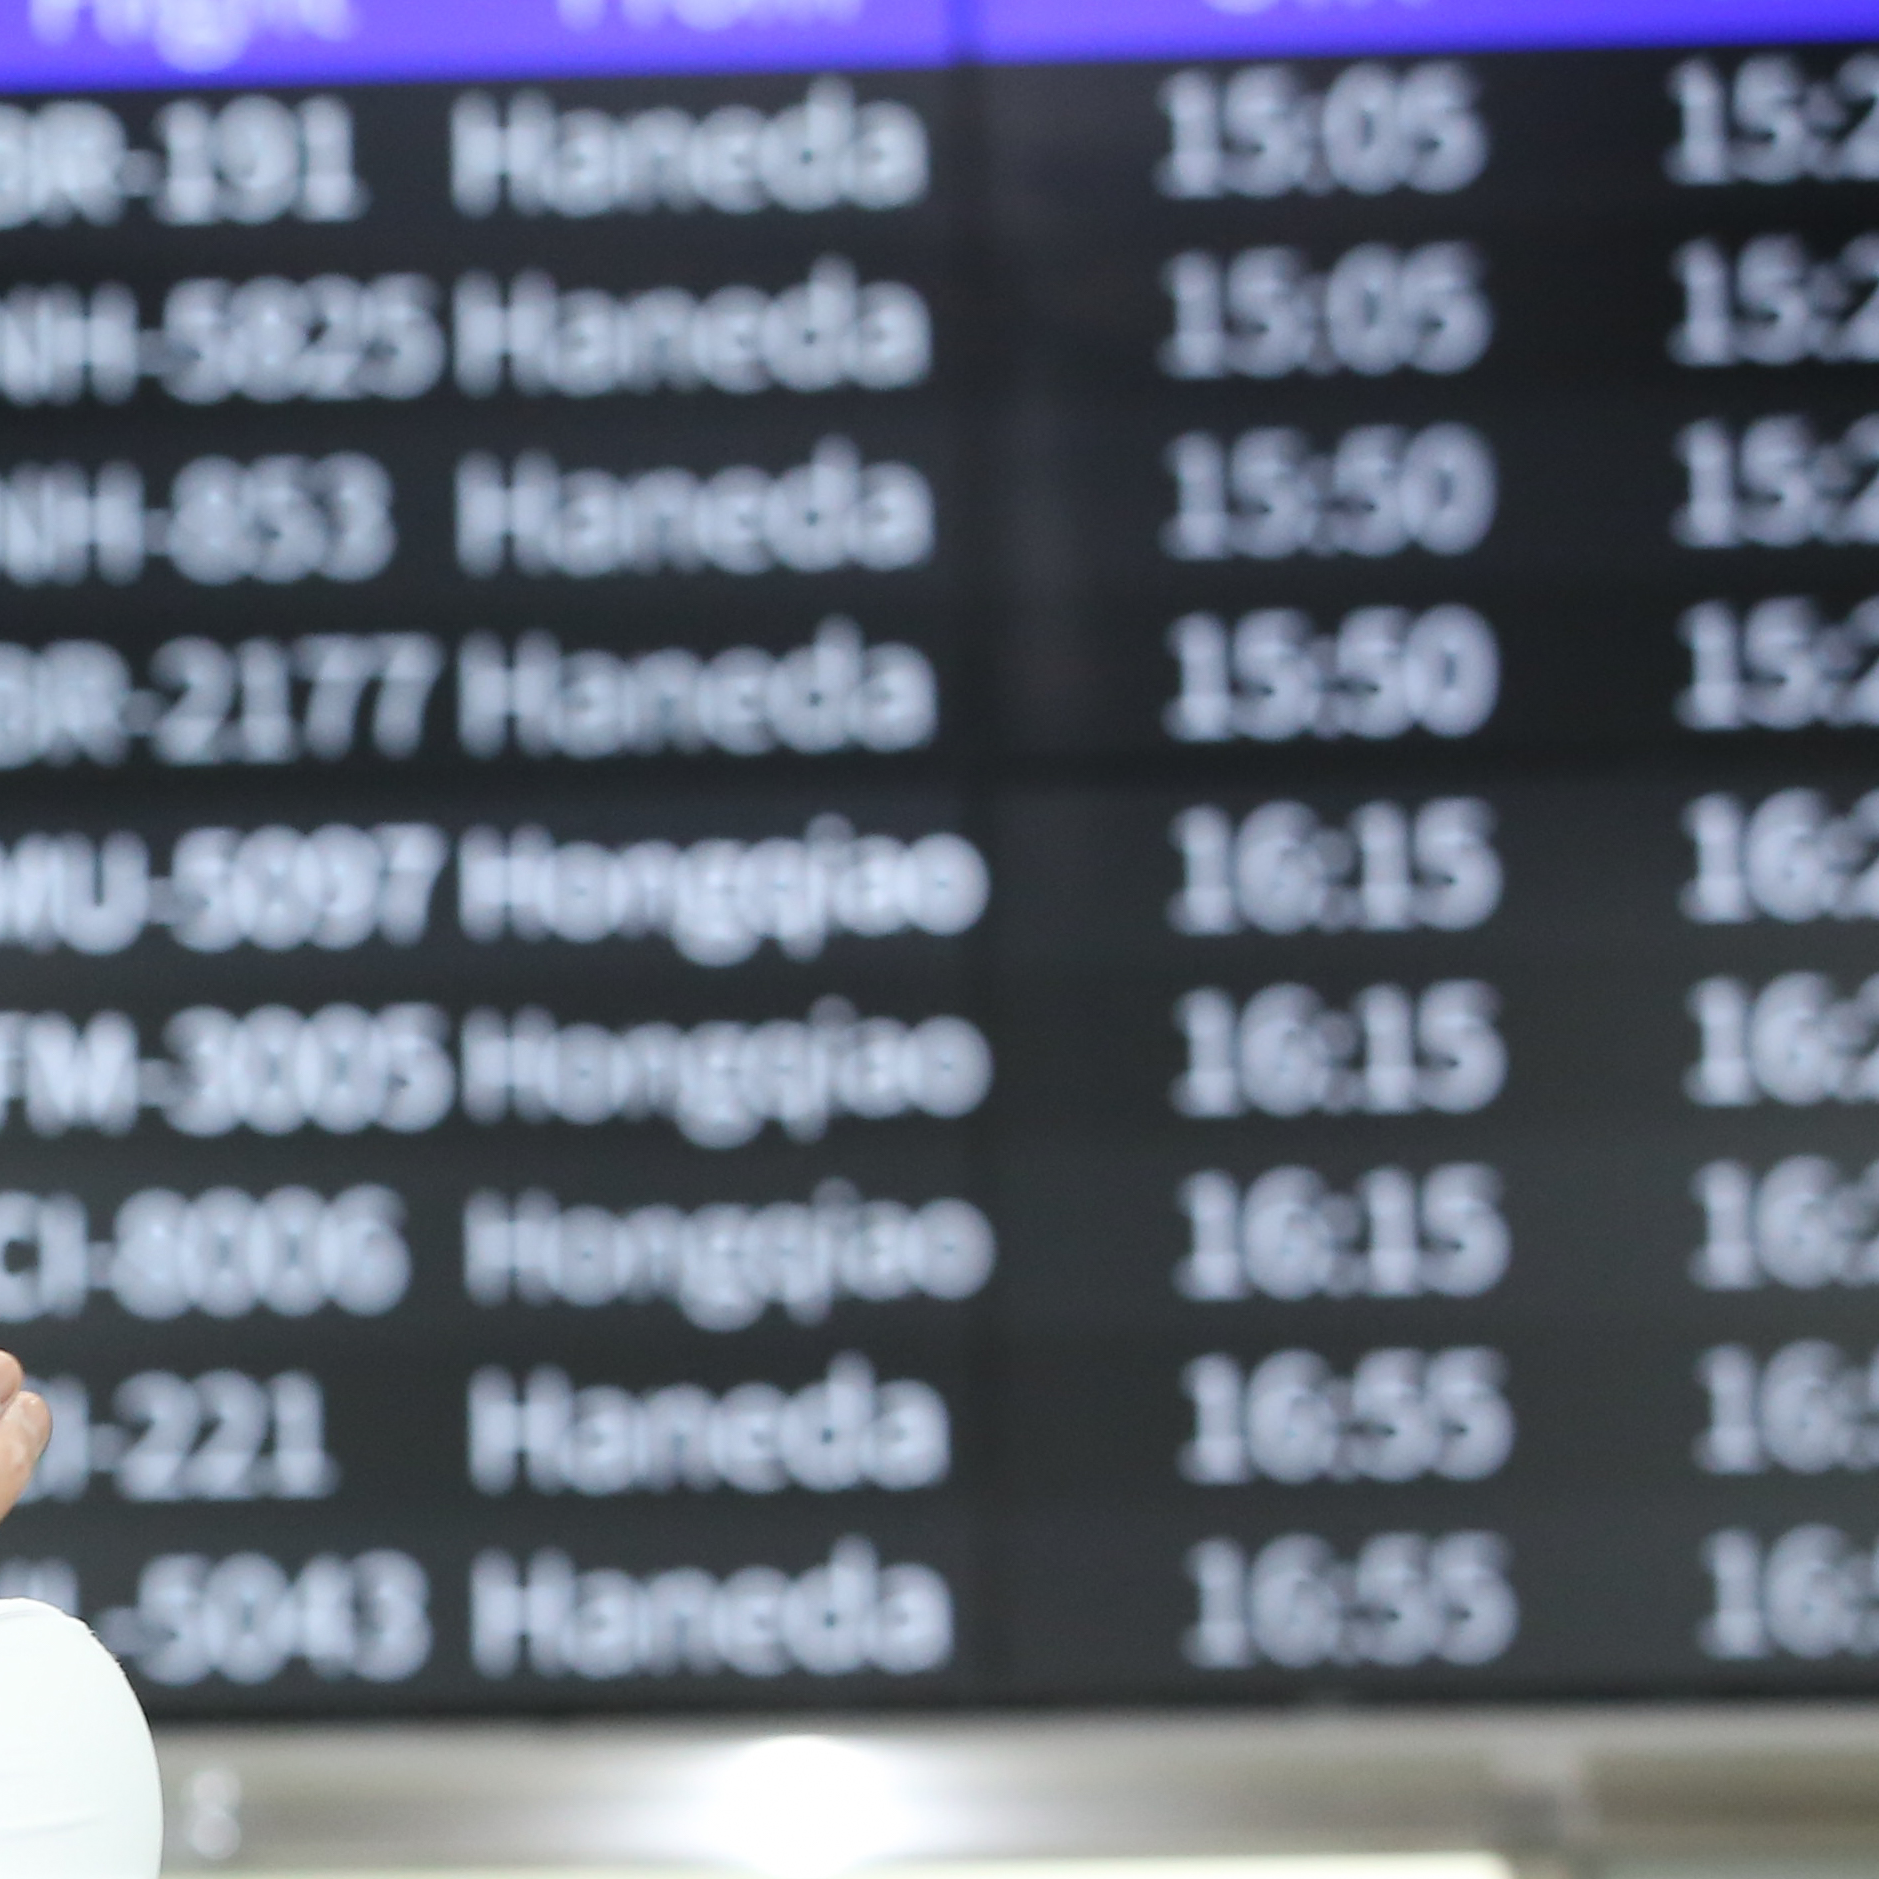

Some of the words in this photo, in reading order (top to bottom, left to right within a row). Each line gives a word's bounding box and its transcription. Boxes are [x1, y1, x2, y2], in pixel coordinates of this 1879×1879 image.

[449, 76, 929, 216] Haneda
[1159, 62, 1486, 198] 15:05
[452, 256, 932, 395] Haneda
[1162, 243, 1490, 378] 15:05
[454, 437, 935, 575] Haneda
[1165, 424, 1496, 560] 15:50
[456, 618, 938, 756] Haneda
[1167, 605, 1499, 741] 15:50
[457, 813, 989, 965] Hongqiao
[1172, 797, 1503, 935] 16:15
[459, 996, 992, 1147] Hongqiao
[1176, 979, 1506, 1117] 16:15
[463, 1180, 995, 1330] Hongqiao
[1179, 1162, 1510, 1300] 16:15
[20, 1368, 338, 1501] I-221
[467, 1354, 950, 1495] Haneda
[1183, 1346, 1514, 1484] 16:55
[469, 1537, 954, 1678] Haneda
[1188, 1530, 1518, 1668] 16:55
